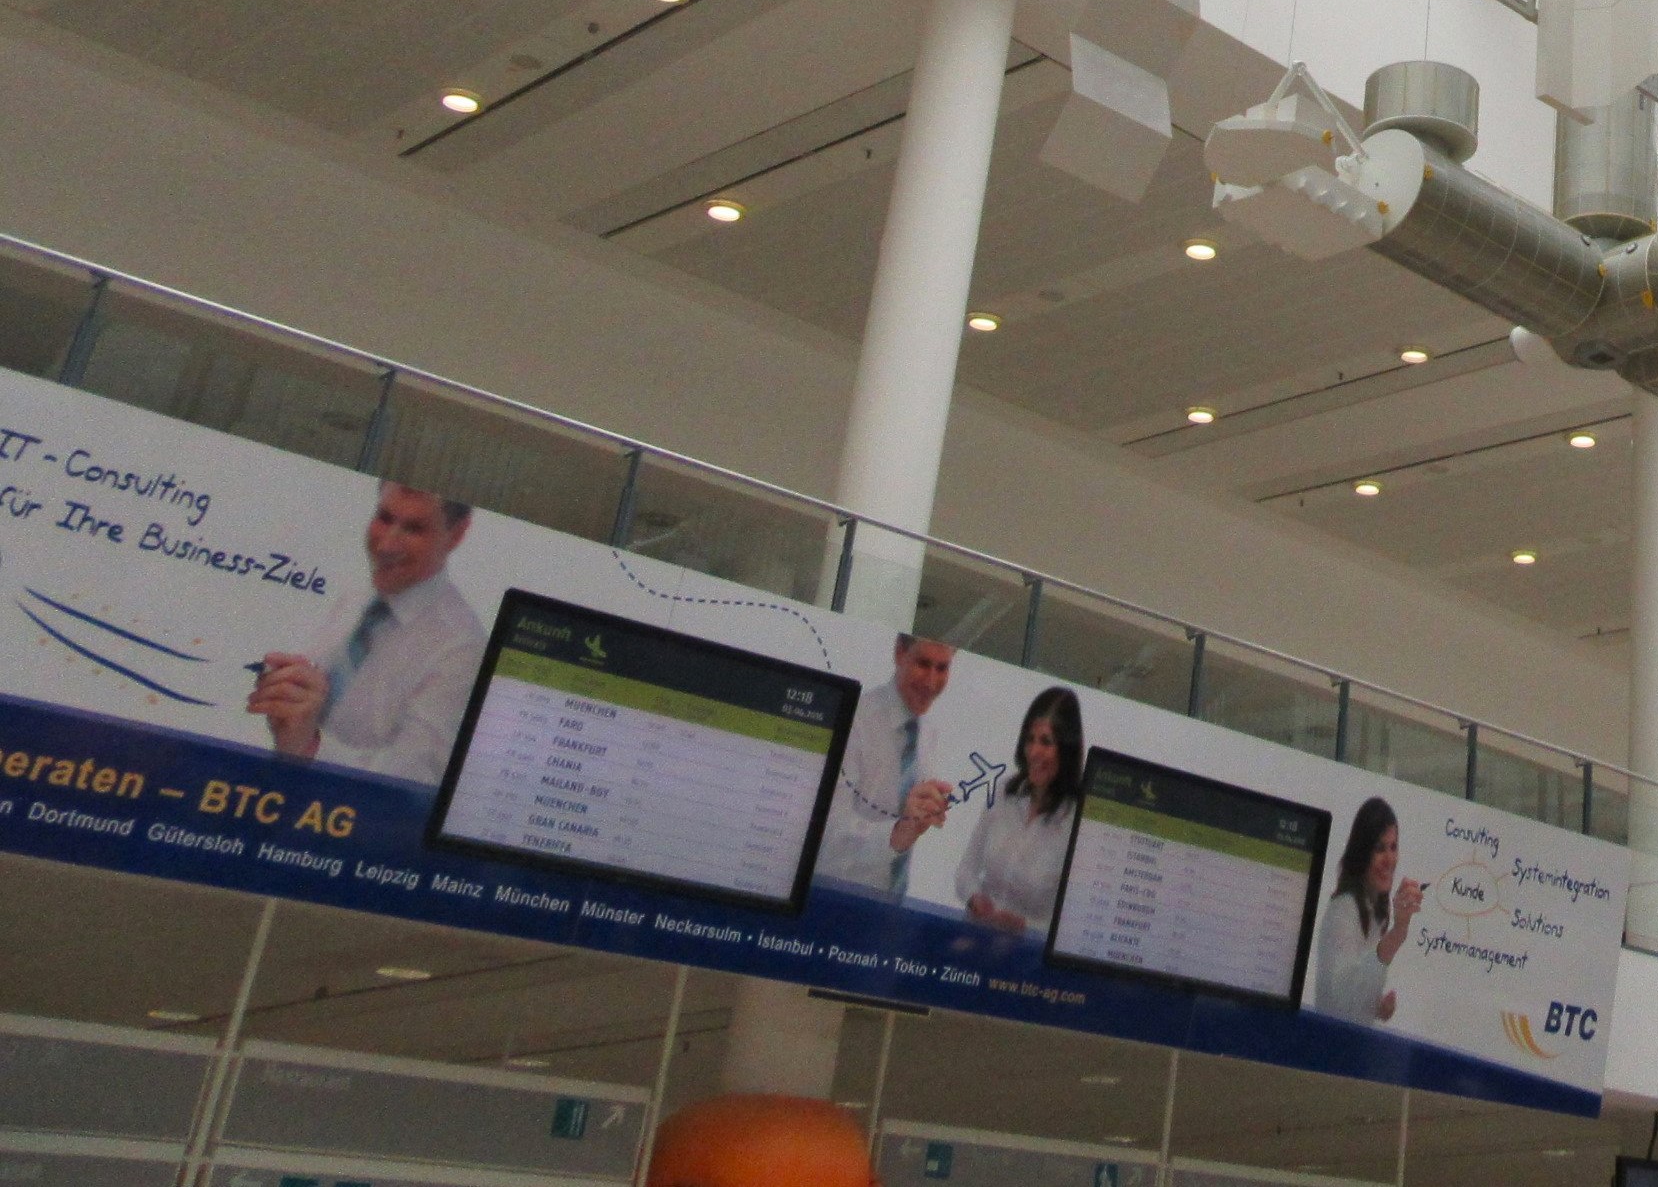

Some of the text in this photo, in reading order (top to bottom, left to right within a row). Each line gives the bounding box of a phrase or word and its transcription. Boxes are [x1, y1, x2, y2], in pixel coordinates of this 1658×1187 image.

[55, 500, 123, 544] Ihre
[139, 522, 327, 596] Business-Ziele
[552, 735, 608, 757] FRANKFURT
[0, 750, 145, 799] eraten
[199, 781, 286, 825] BTC
[293, 801, 358, 838] AG
[1445, 817, 1500, 859] Consulting
[28, 801, 136, 836] Dortmund
[147, 821, 245, 856] Gütersloh
[256, 842, 344, 877] Hamburg
[355, 860, 421, 891] Leipzig
[430, 873, 484, 899] Mainz
[495, 885, 570, 913] München
[580, 900, 646, 926] Münster
[654, 913, 742, 943] Neckarsulm
[894, 956, 928, 977] Tokio
[940, 964, 981, 987] Zürich
[1451, 876, 1486, 903] Kunde
[1510, 857, 1611, 903] Systemintegration
[1511, 907, 1564, 938] Solutions
[1416, 927, 1529, 973] Systemmanagement
[1544, 1000, 1598, 1041] BTC
